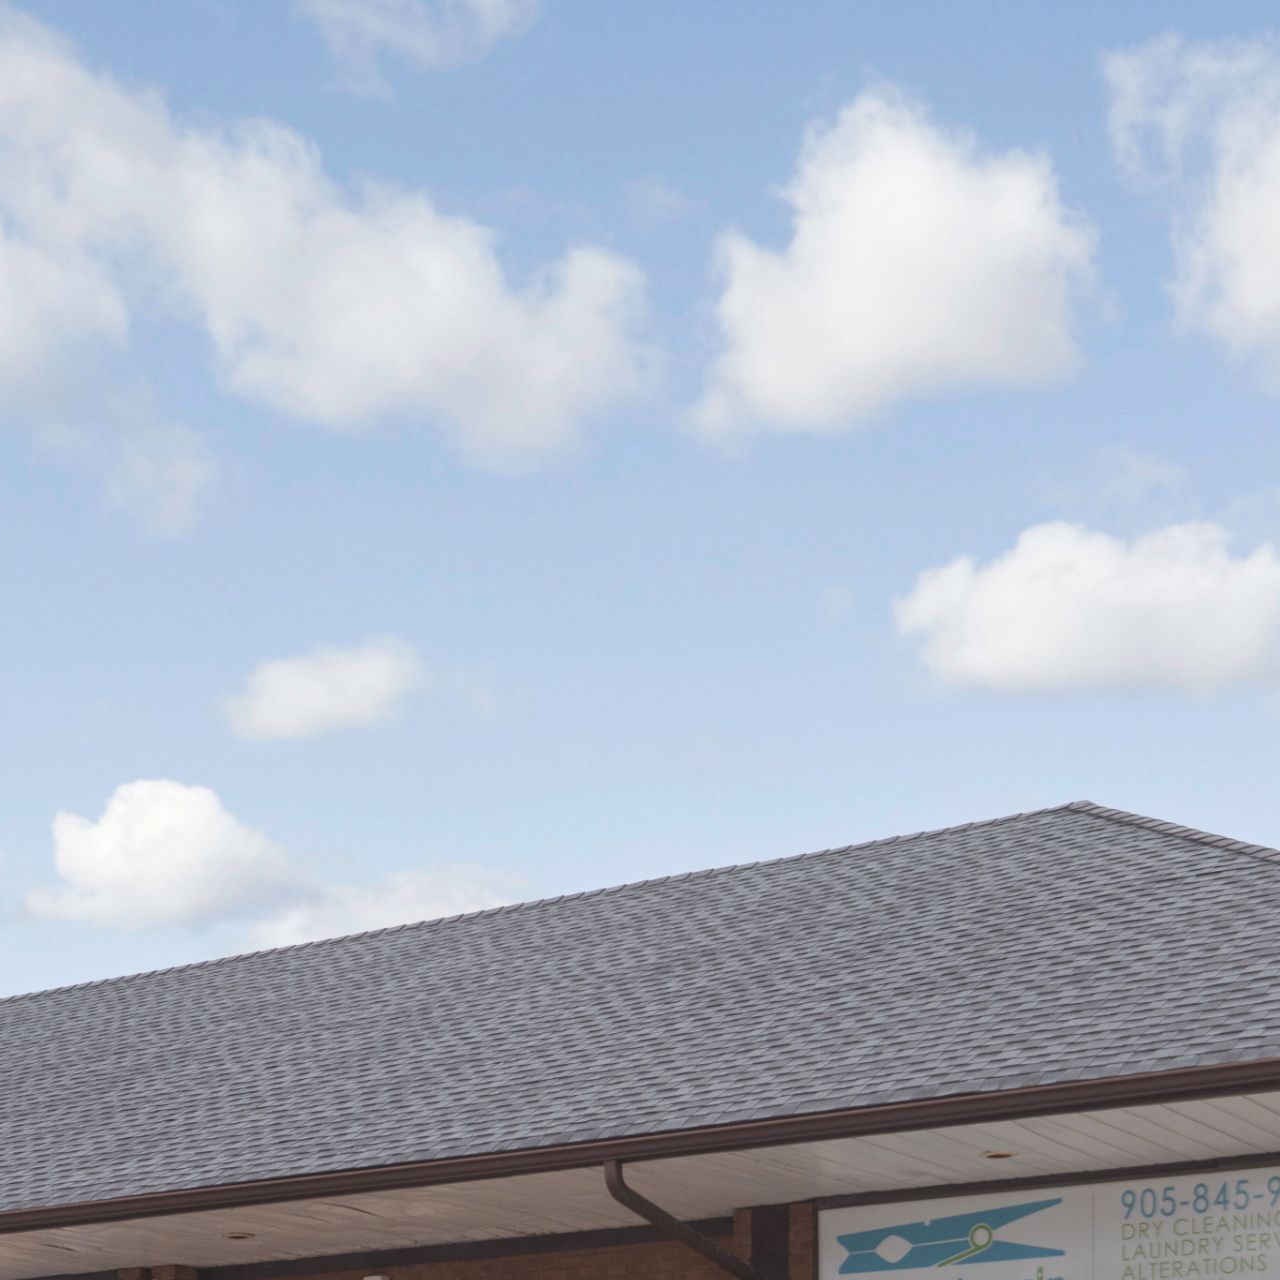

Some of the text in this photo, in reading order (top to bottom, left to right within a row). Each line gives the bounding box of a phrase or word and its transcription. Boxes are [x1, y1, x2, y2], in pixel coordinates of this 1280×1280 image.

[1122, 1221, 1163, 1240] DRY
[1122, 1236, 1224, 1261] LAUNDRY
[1122, 1254, 1267, 1280] ALTERATIONS
